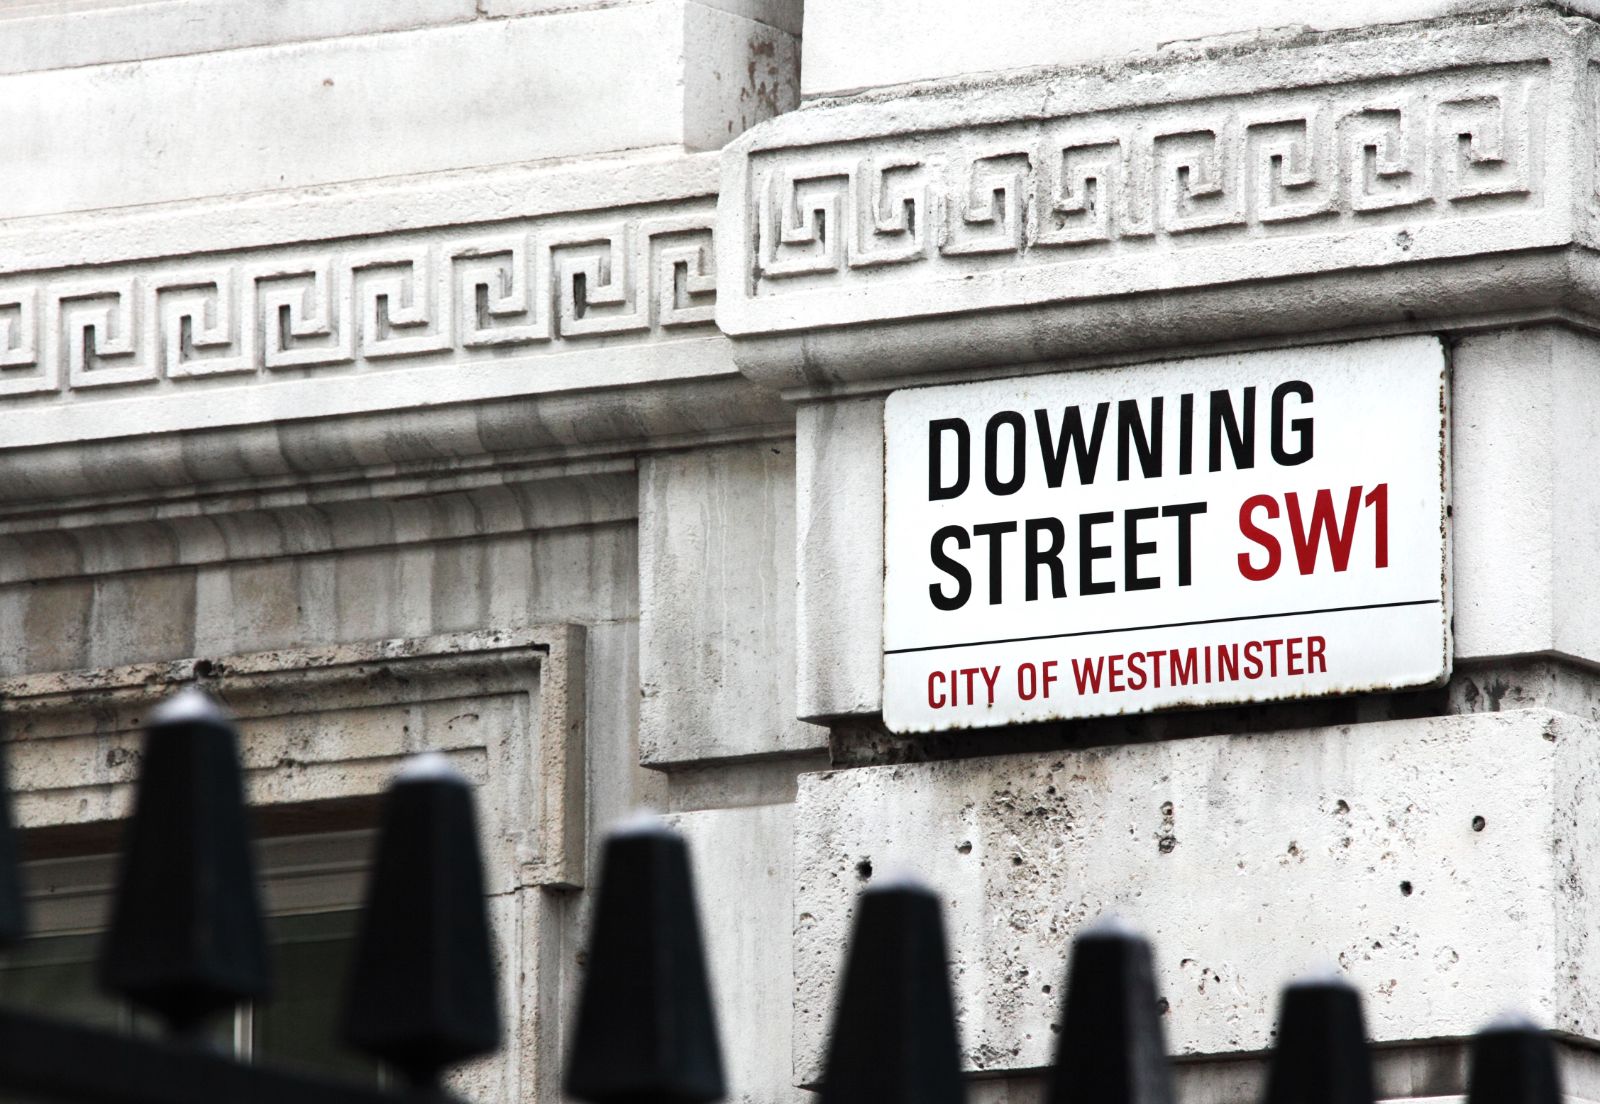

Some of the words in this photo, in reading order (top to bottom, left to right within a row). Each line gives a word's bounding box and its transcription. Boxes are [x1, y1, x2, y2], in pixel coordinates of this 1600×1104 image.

[928, 380, 1314, 502] DOWNING
[928, 501, 1208, 611] STREET
[1238, 483, 1389, 582] SW1
[928, 667, 1001, 710] CITY
[1018, 661, 1058, 701] OF
[1072, 635, 1327, 696] WESTMINSTER
